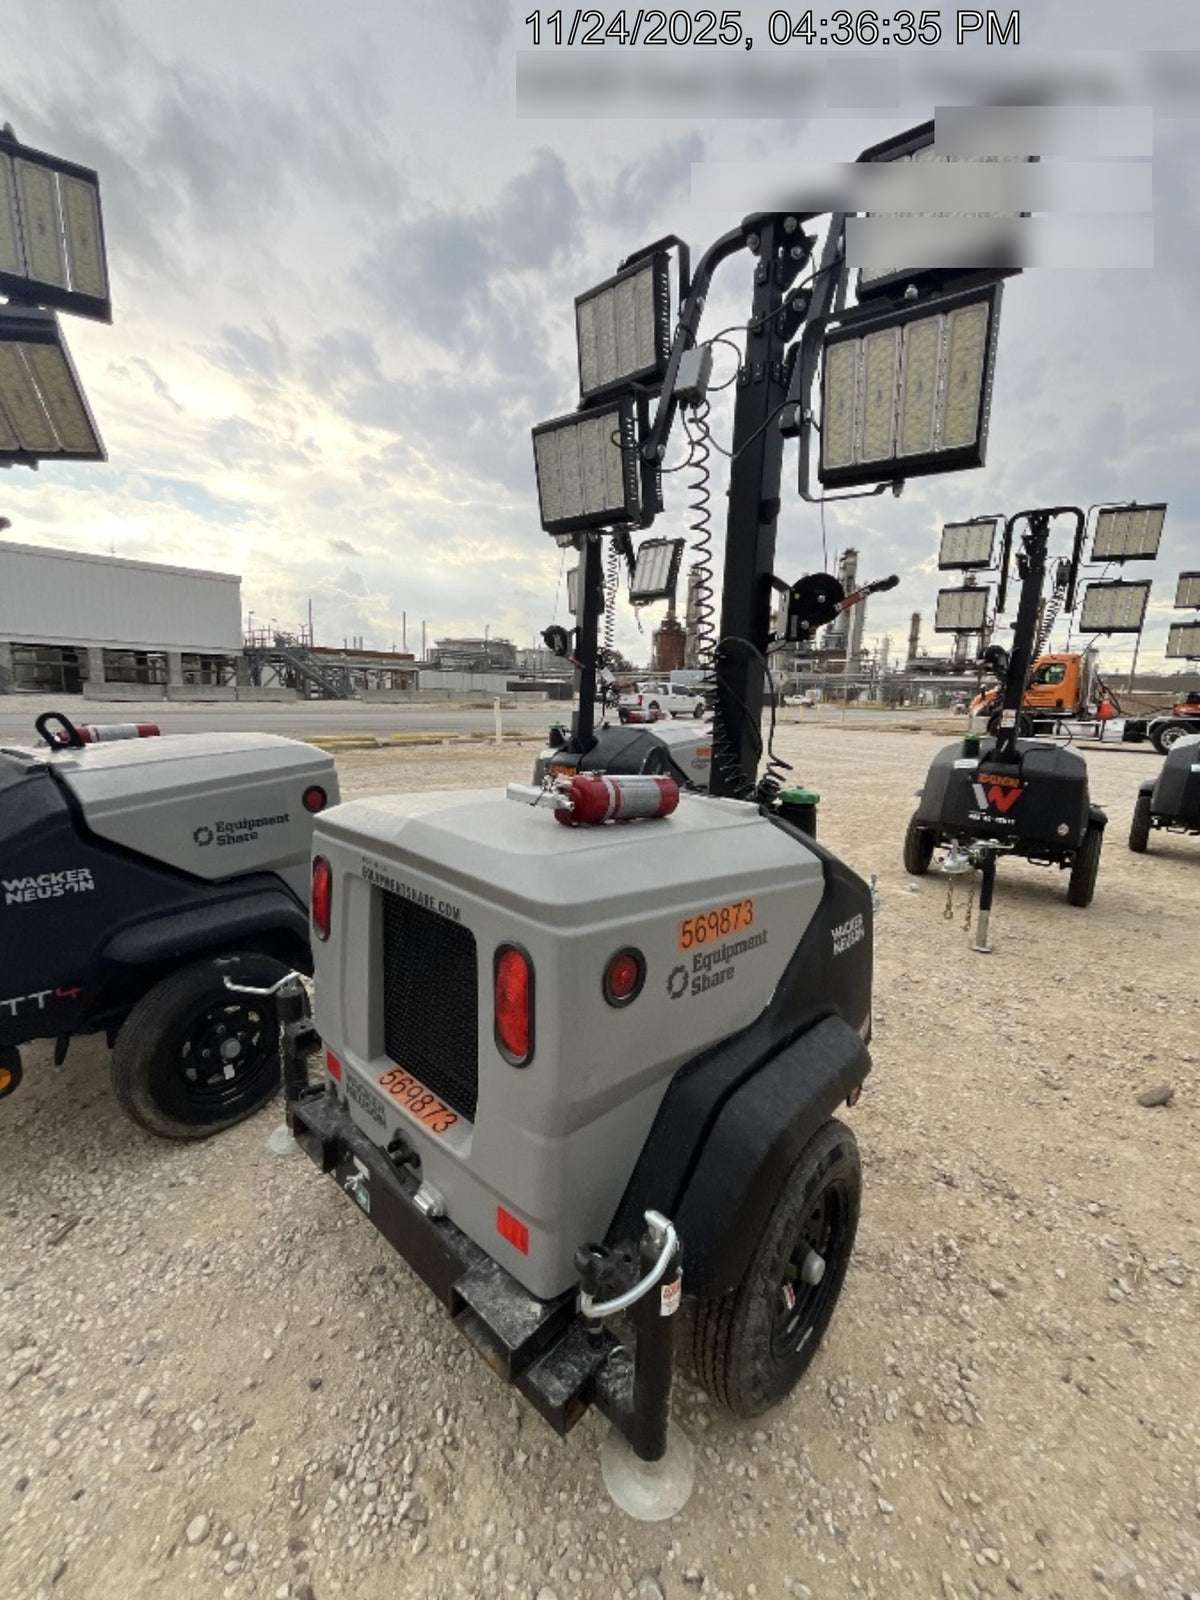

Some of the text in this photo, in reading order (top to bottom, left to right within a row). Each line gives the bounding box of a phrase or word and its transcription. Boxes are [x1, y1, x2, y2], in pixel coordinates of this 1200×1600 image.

[215, 813, 290, 833] Equipment
[216, 831, 258, 846] Share
[1, 868, 93, 891] WACKER
[681, 899, 754, 949] 569873
[692, 929, 768, 974] Equipment
[691, 965, 735, 996] Share
[379, 1068, 458, 1134] 569873
